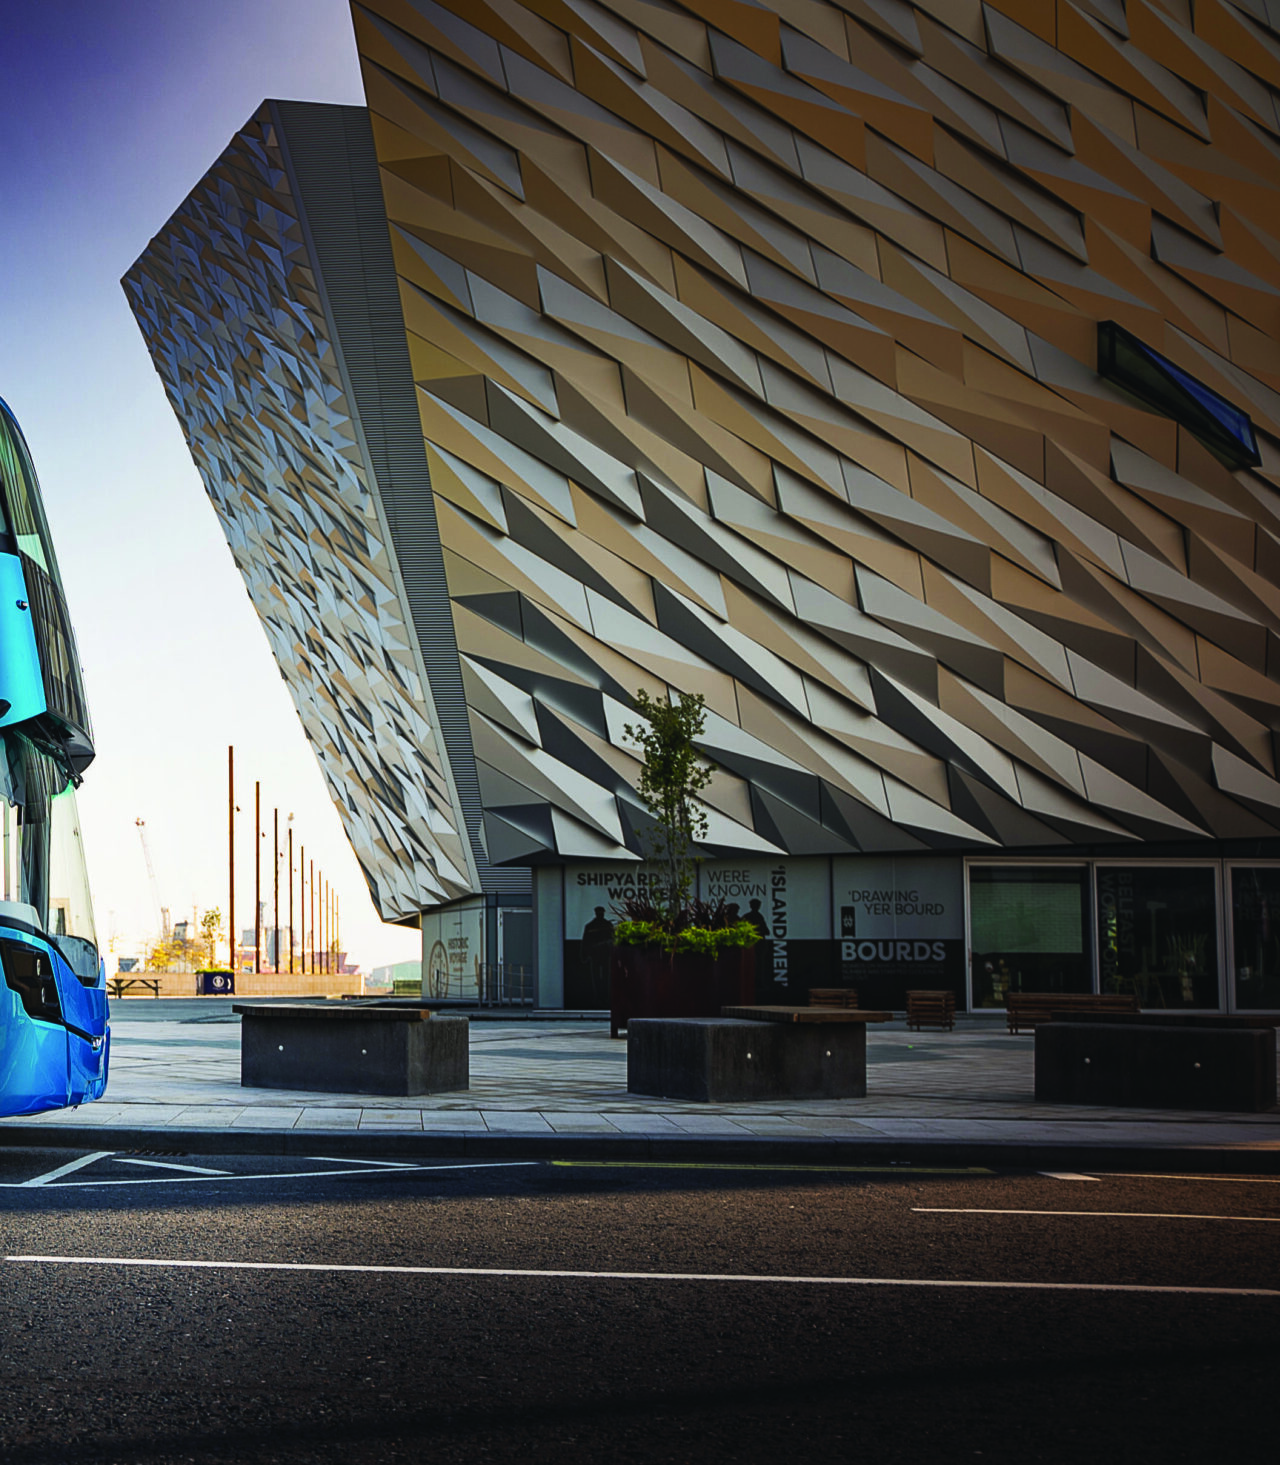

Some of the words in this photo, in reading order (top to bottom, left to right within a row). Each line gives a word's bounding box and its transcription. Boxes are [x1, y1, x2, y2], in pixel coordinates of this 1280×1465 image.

[577, 872, 660, 886] SHIPYARD
[707, 869, 751, 883] WERE
[708, 883, 767, 897] KNOWN
[864, 903, 891, 915] YER
[895, 903, 945, 916] BOURD
[1118, 872, 1135, 956] BELFAST
[841, 940, 946, 962] BOURDS
